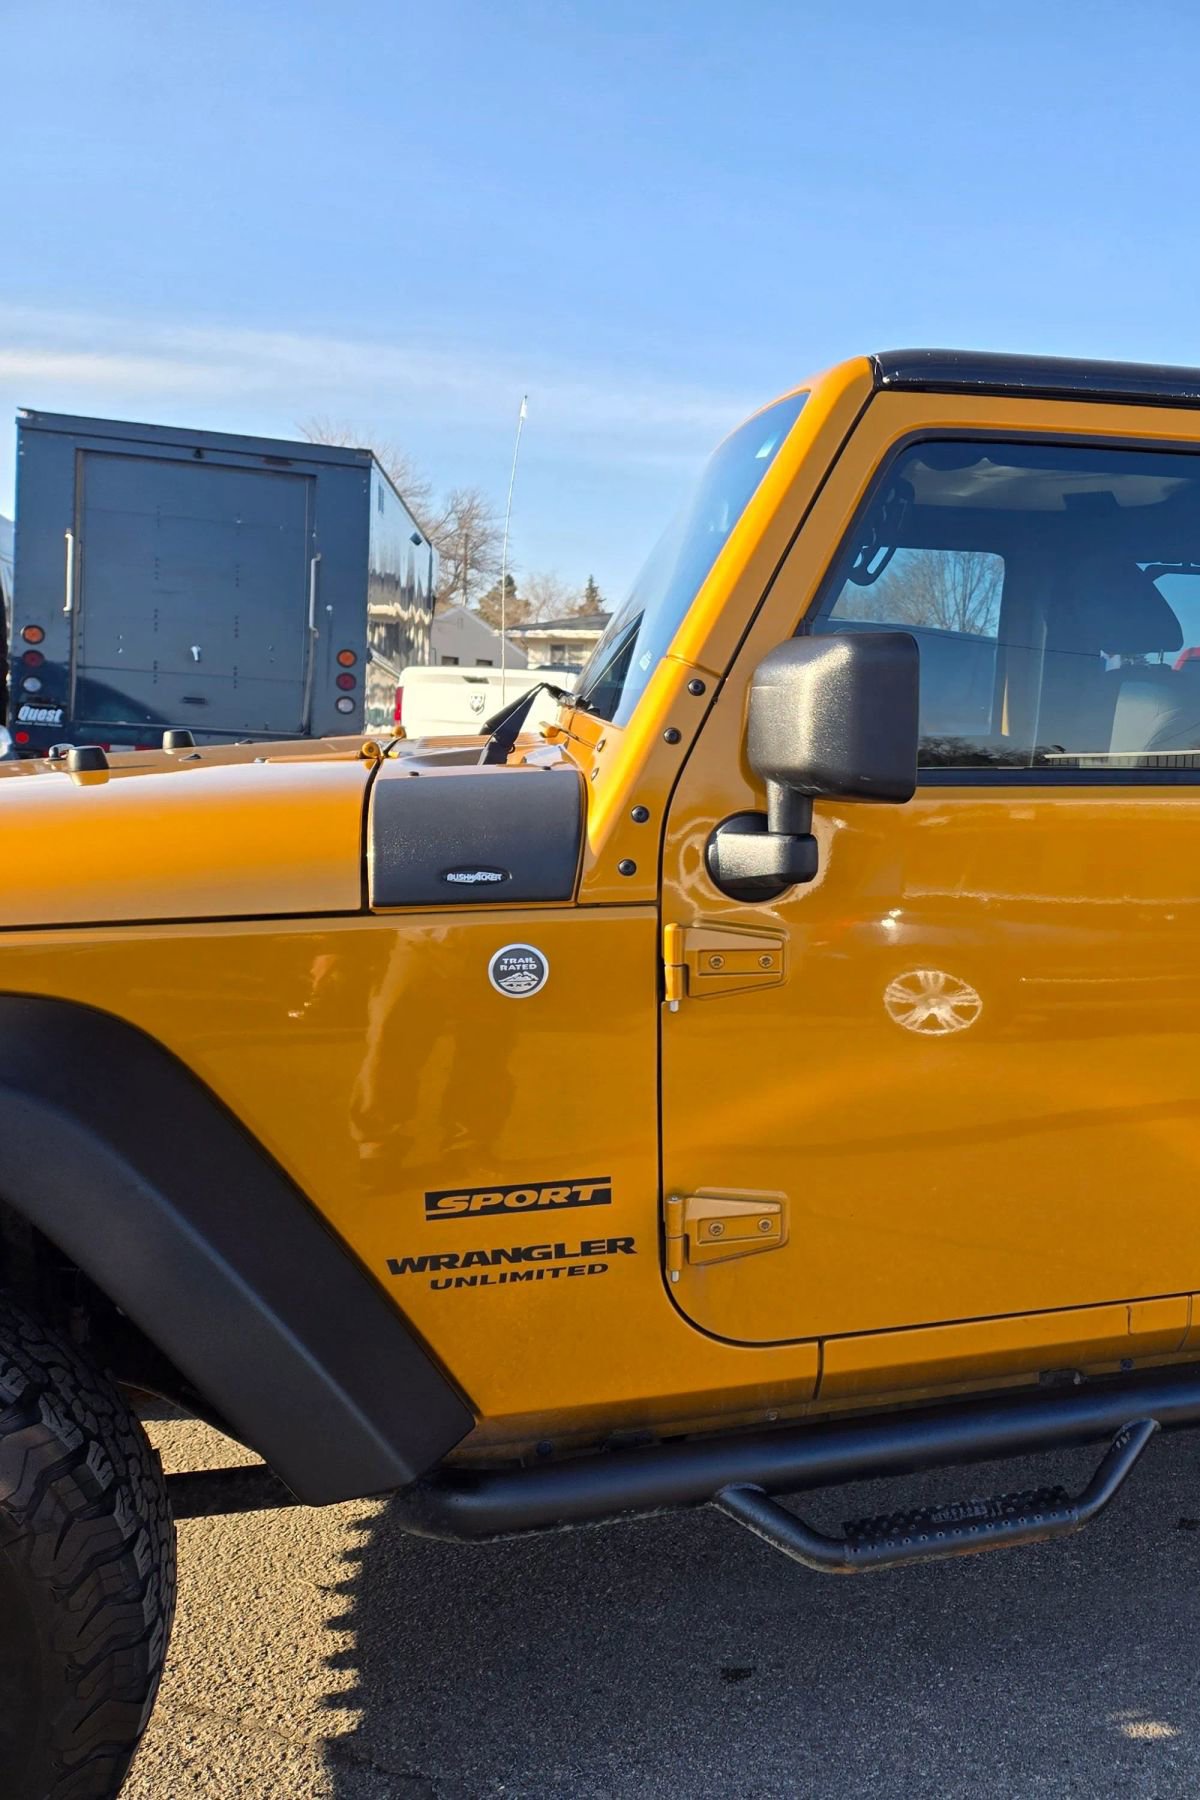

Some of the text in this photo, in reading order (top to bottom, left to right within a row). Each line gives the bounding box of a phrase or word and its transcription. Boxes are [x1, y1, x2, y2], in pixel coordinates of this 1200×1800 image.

[500, 963, 537, 971] RATED
[502, 956, 536, 965] TRAIL
[432, 1184, 608, 1215] SPORT
[386, 1236, 638, 1275] WRANGLER
[430, 1262, 609, 1291] UNLIMITED
